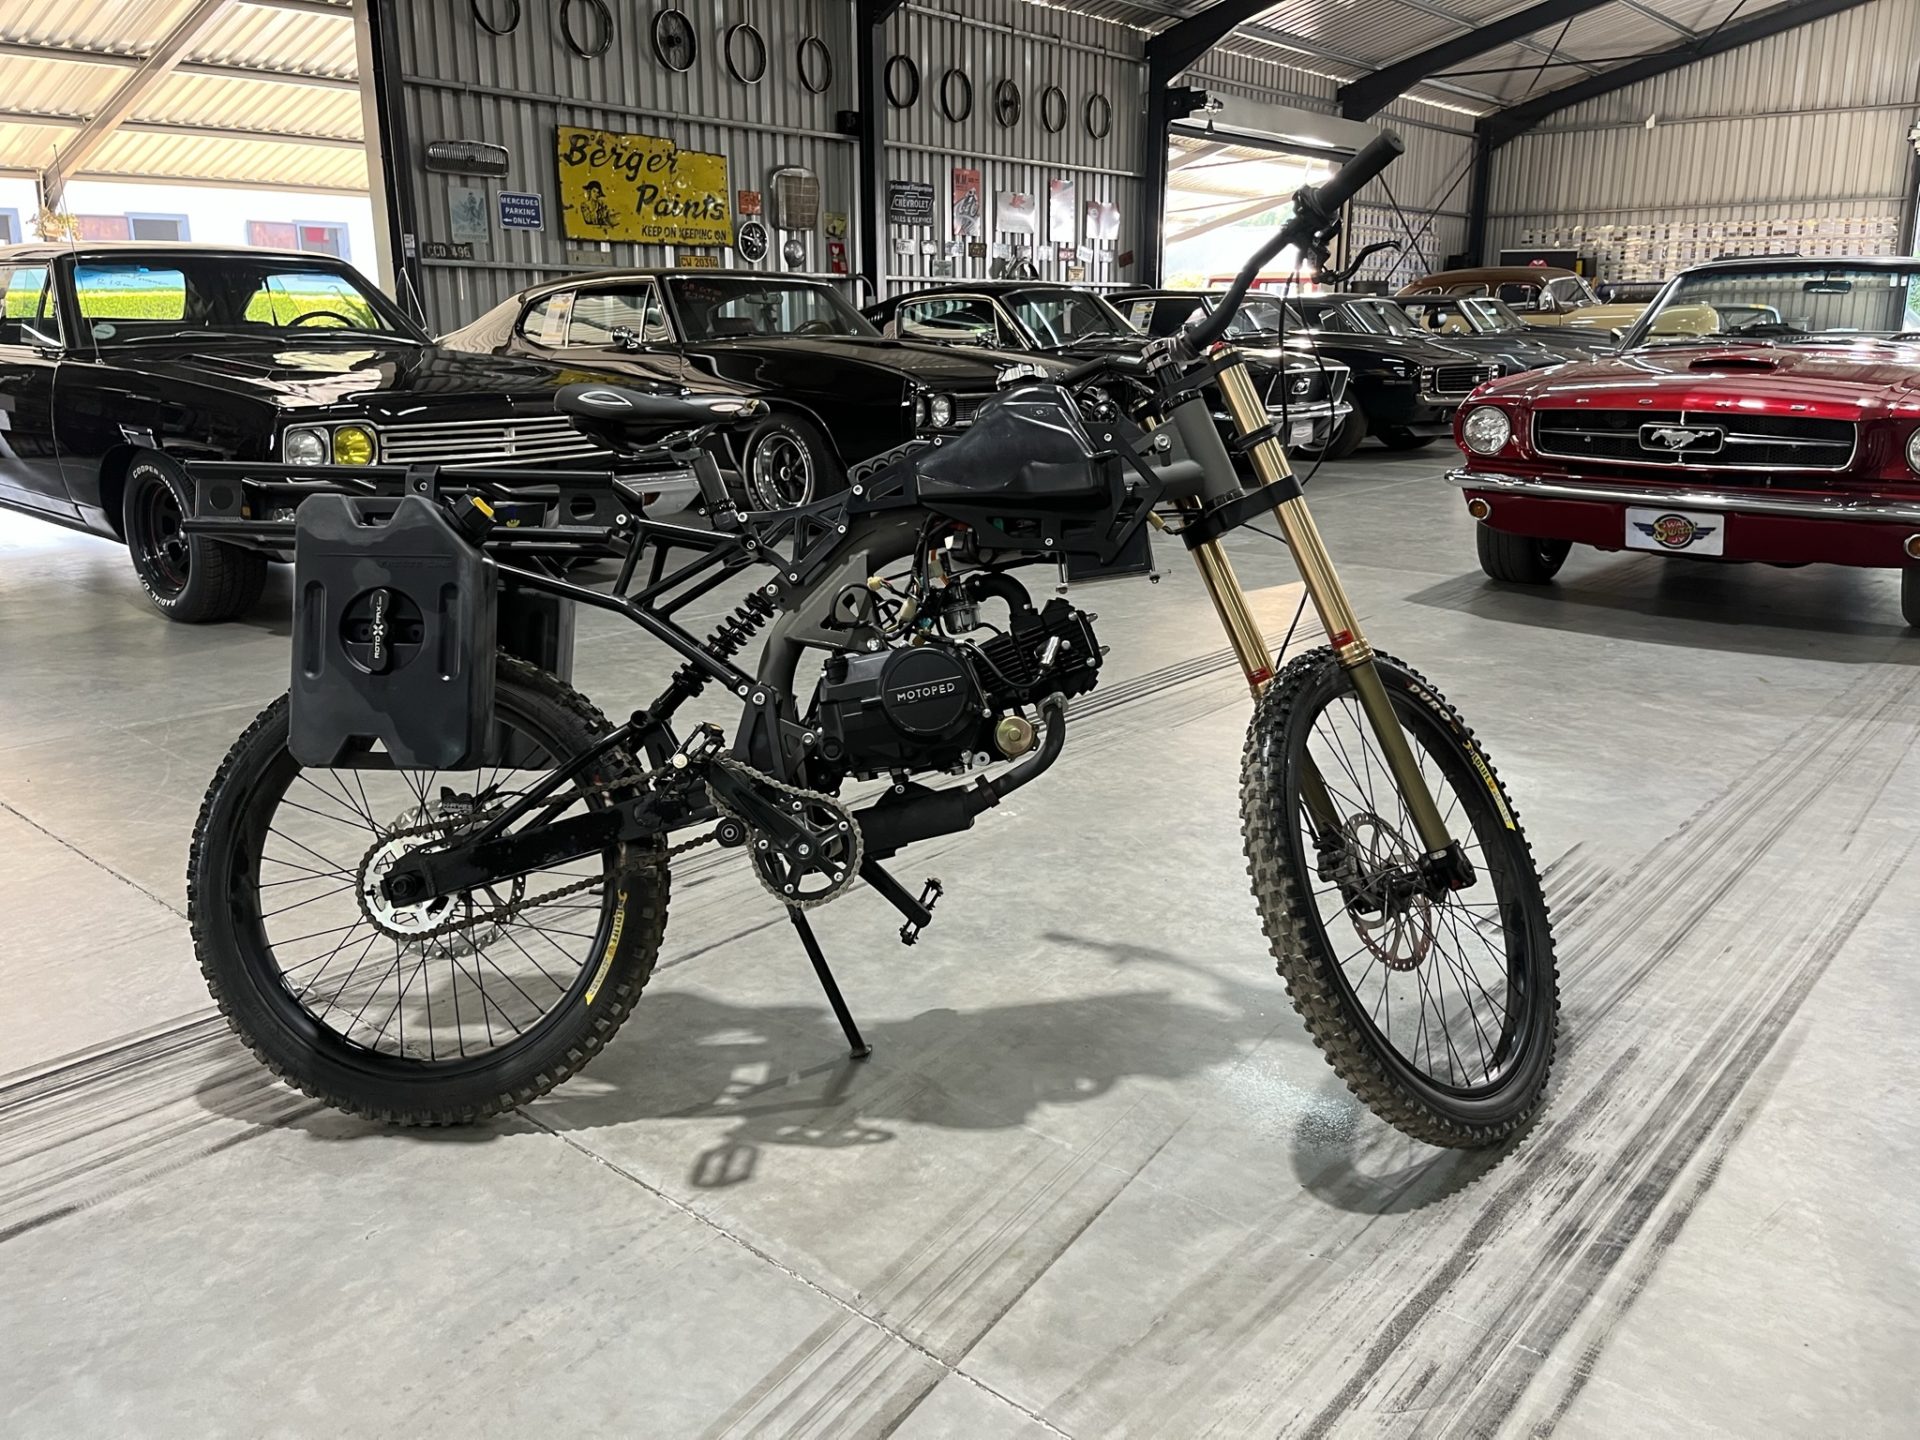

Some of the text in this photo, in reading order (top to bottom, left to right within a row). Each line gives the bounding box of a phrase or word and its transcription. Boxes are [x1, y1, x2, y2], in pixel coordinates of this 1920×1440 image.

[563, 134, 678, 182] Berger
[500, 197, 539, 206] MERCEDES
[635, 184, 725, 221] Paints
[894, 198, 929, 209] CHEVROLET
[505, 207, 536, 216] PARKING
[641, 225, 727, 242] KEEP ON KEEPING ON
[133, 465, 159, 479] COOPER
[151, 590, 177, 607] RADIAL
[897, 682, 955, 701] MOTOPED
[1407, 682, 1452, 722] DURO
